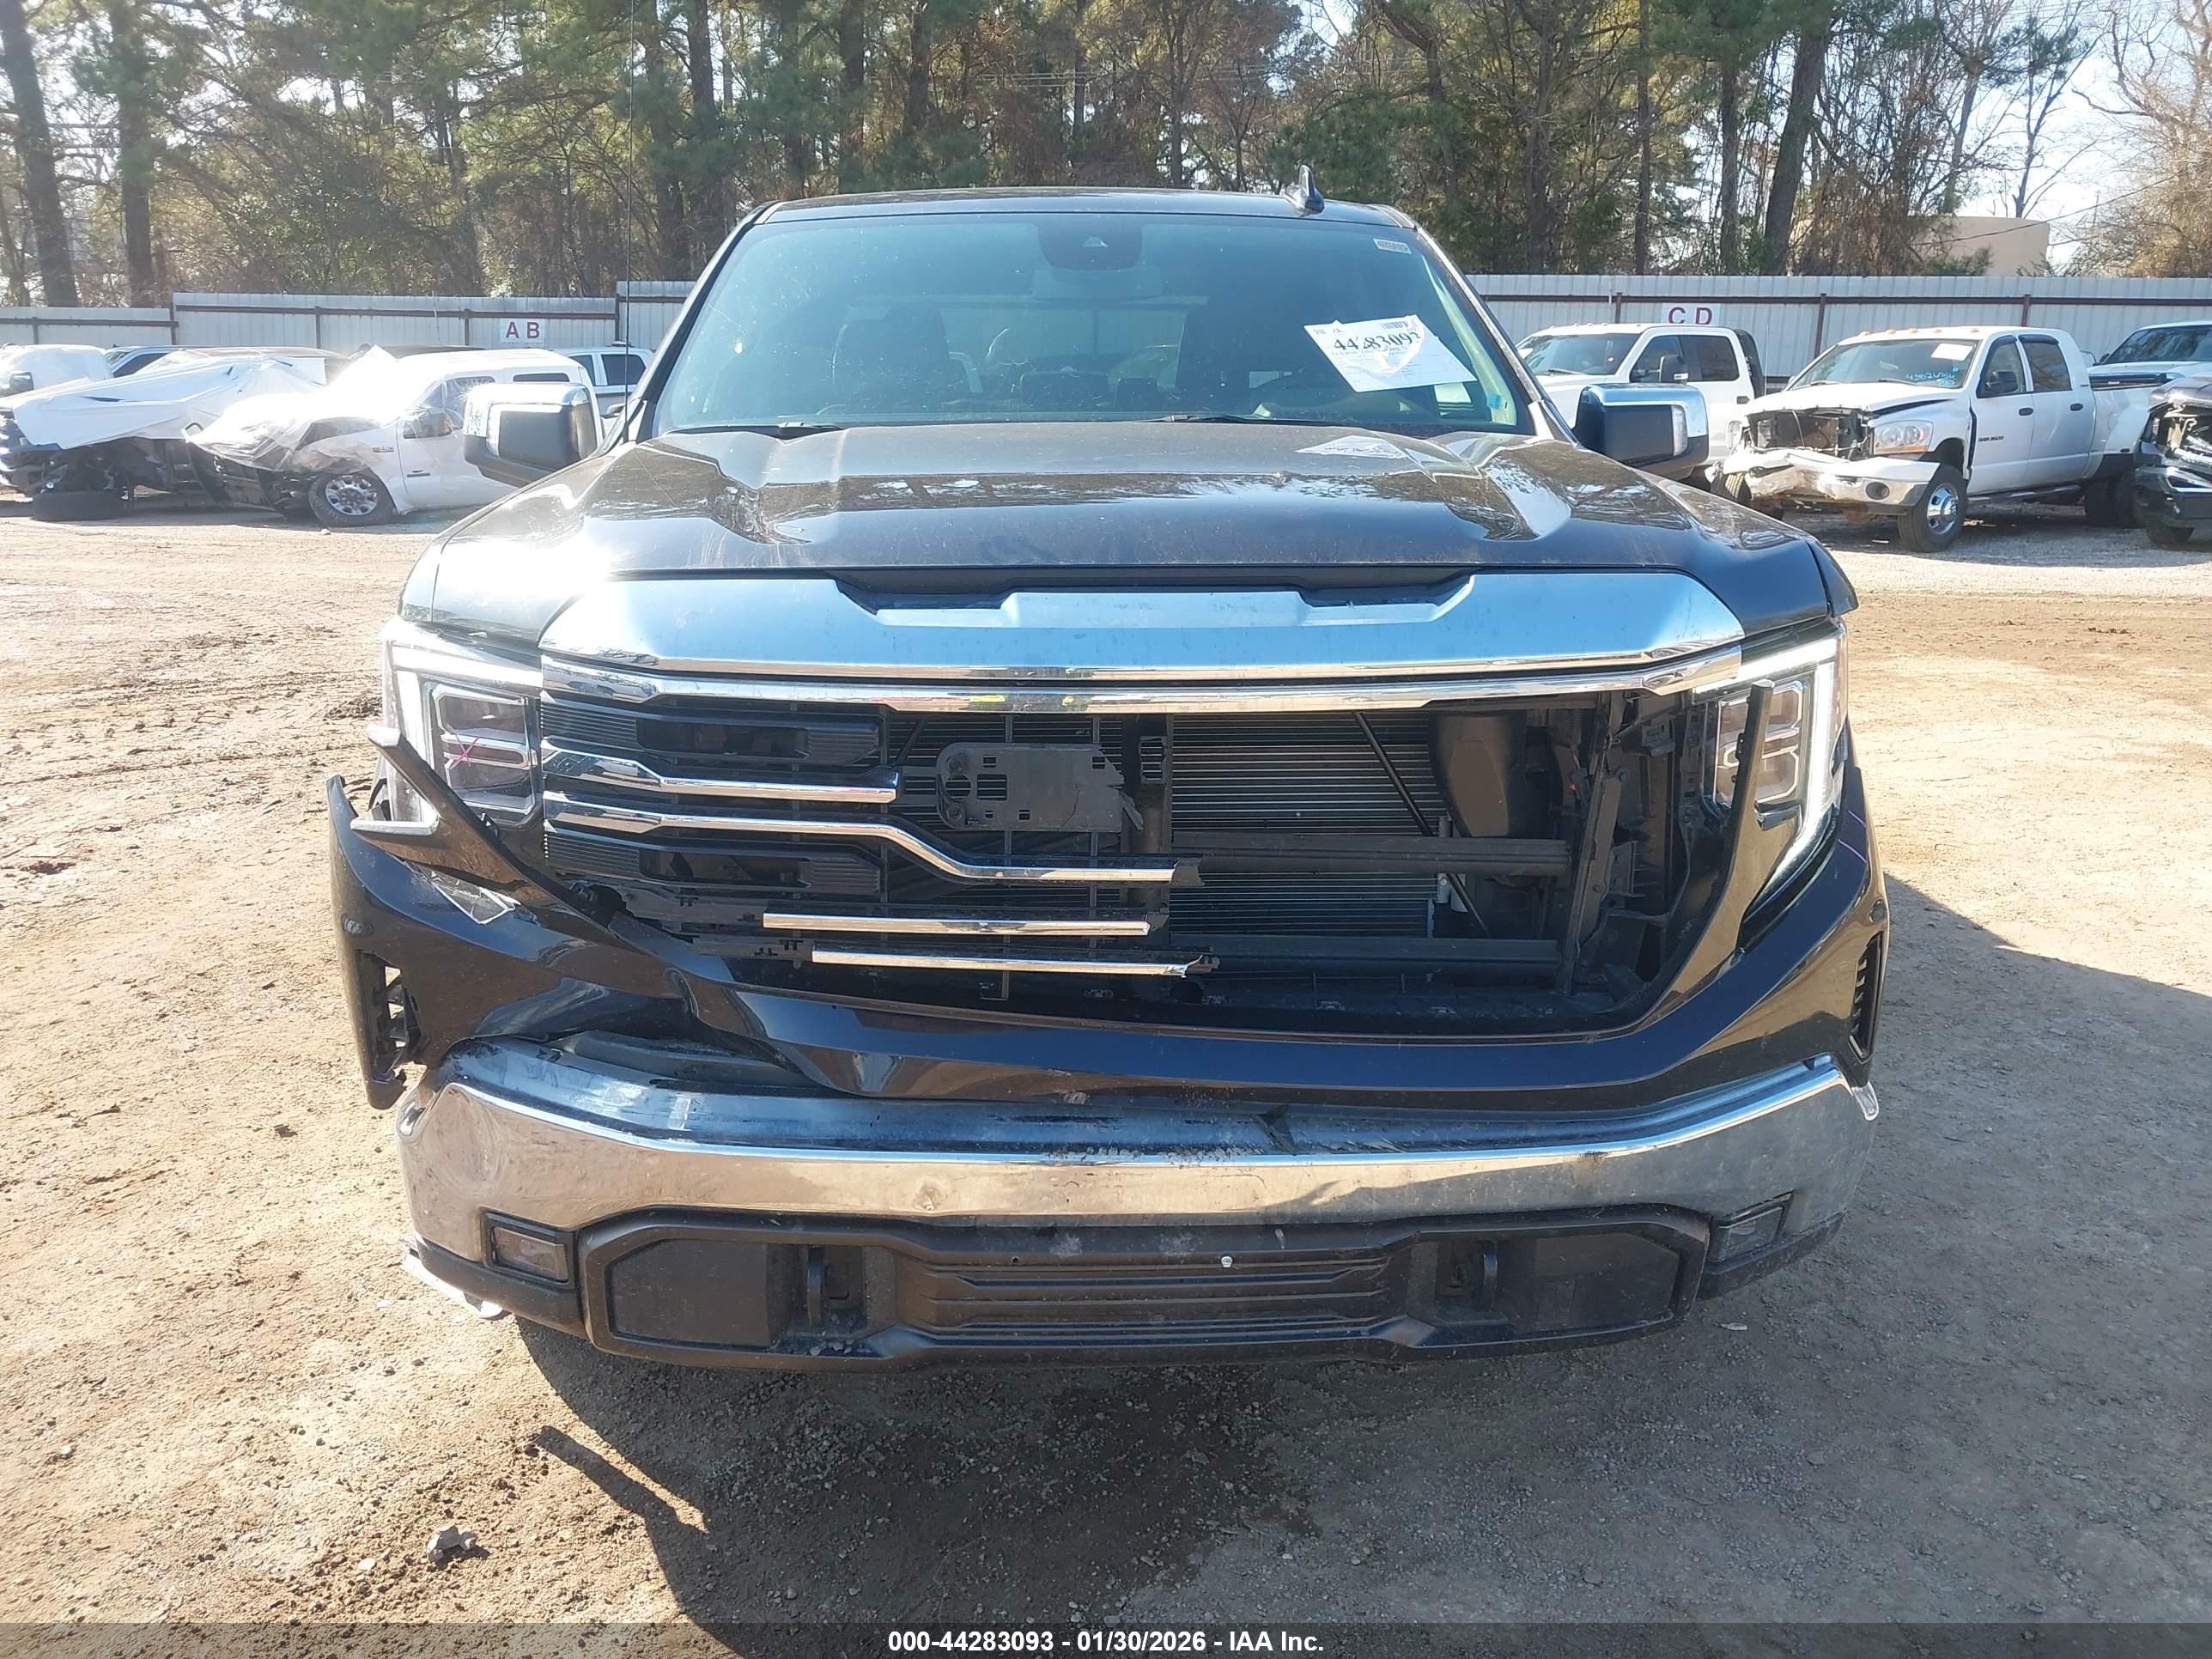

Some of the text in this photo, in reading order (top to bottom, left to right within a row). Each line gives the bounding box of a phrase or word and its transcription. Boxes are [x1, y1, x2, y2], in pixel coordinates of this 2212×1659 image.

[1668, 307, 1712, 325] C D
[506, 321, 540, 339] A B
